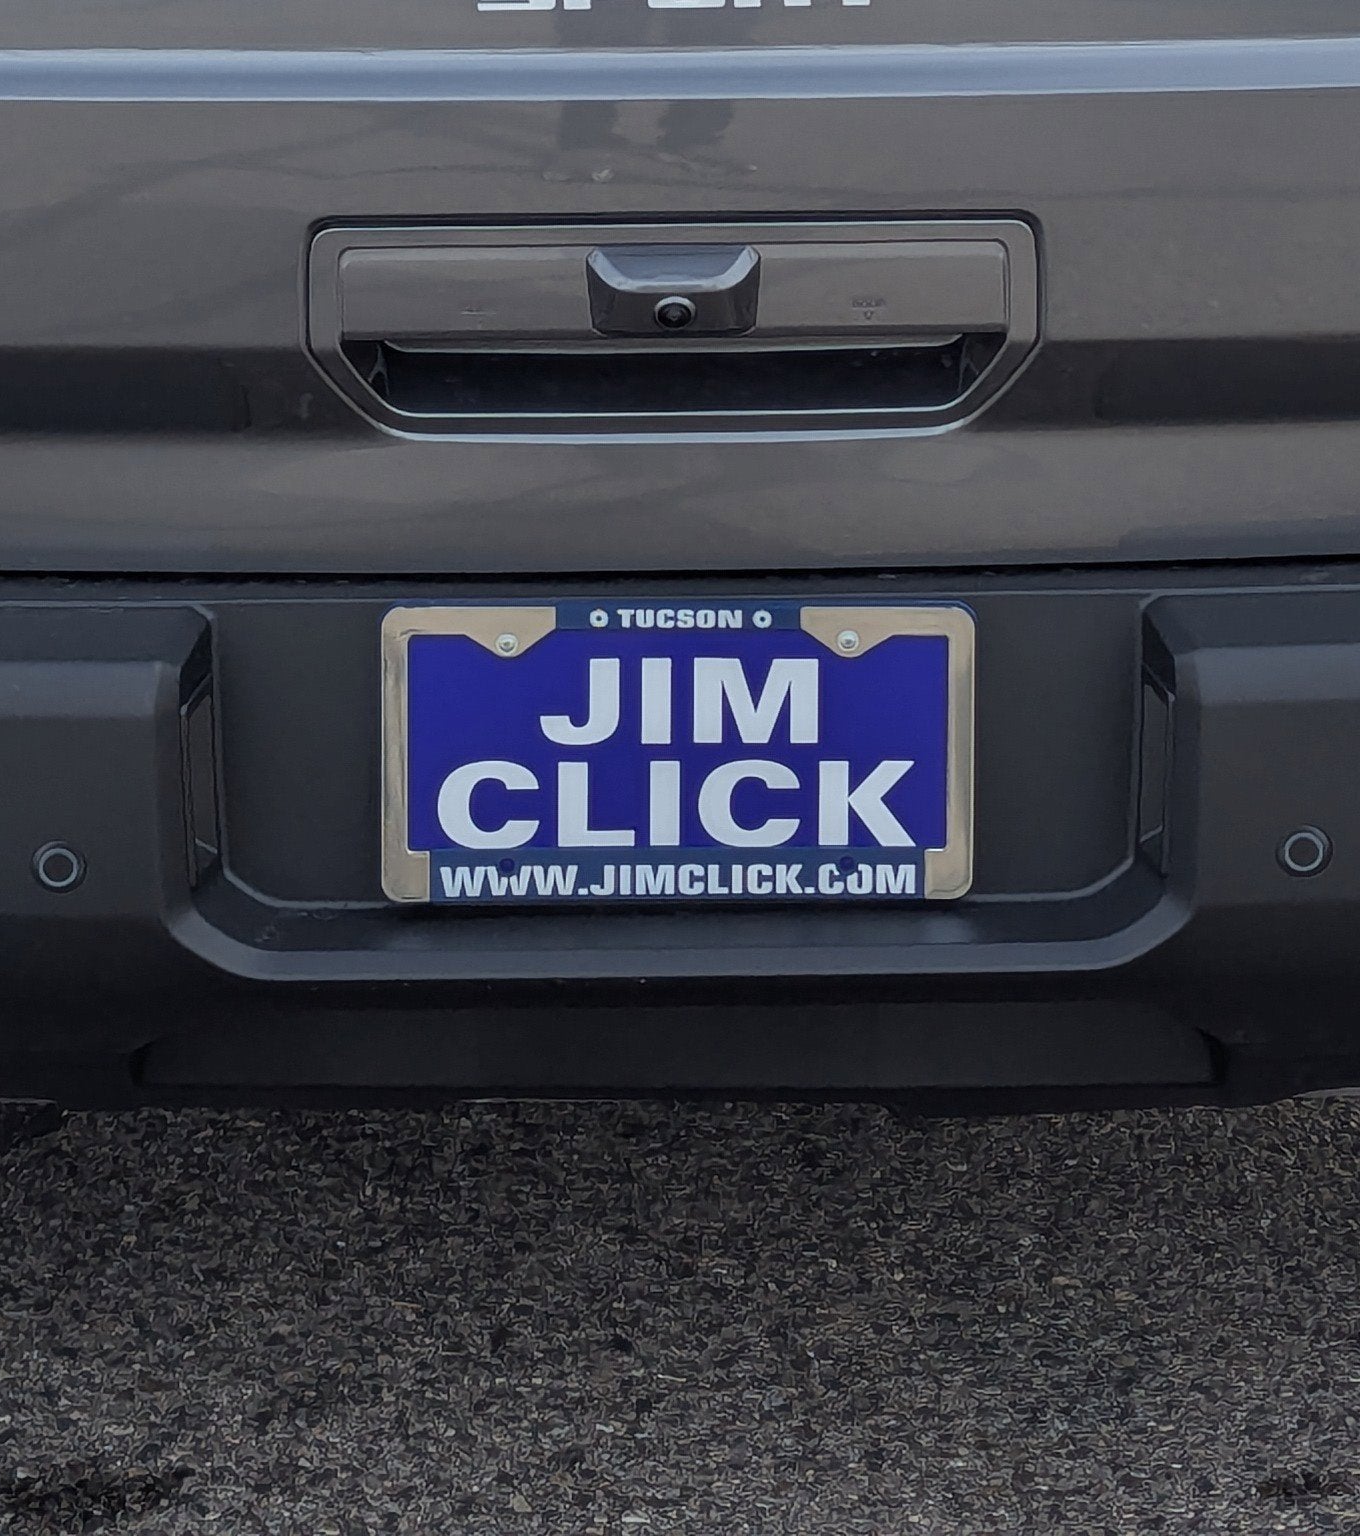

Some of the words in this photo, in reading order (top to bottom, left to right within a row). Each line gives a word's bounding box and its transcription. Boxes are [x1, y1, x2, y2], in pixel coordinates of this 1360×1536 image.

[617, 608, 743, 629] TUCSON
[540, 657, 819, 745] JIM
[437, 760, 917, 849] CLICK
[439, 863, 916, 897] WWW.JIMCLICK.COM
